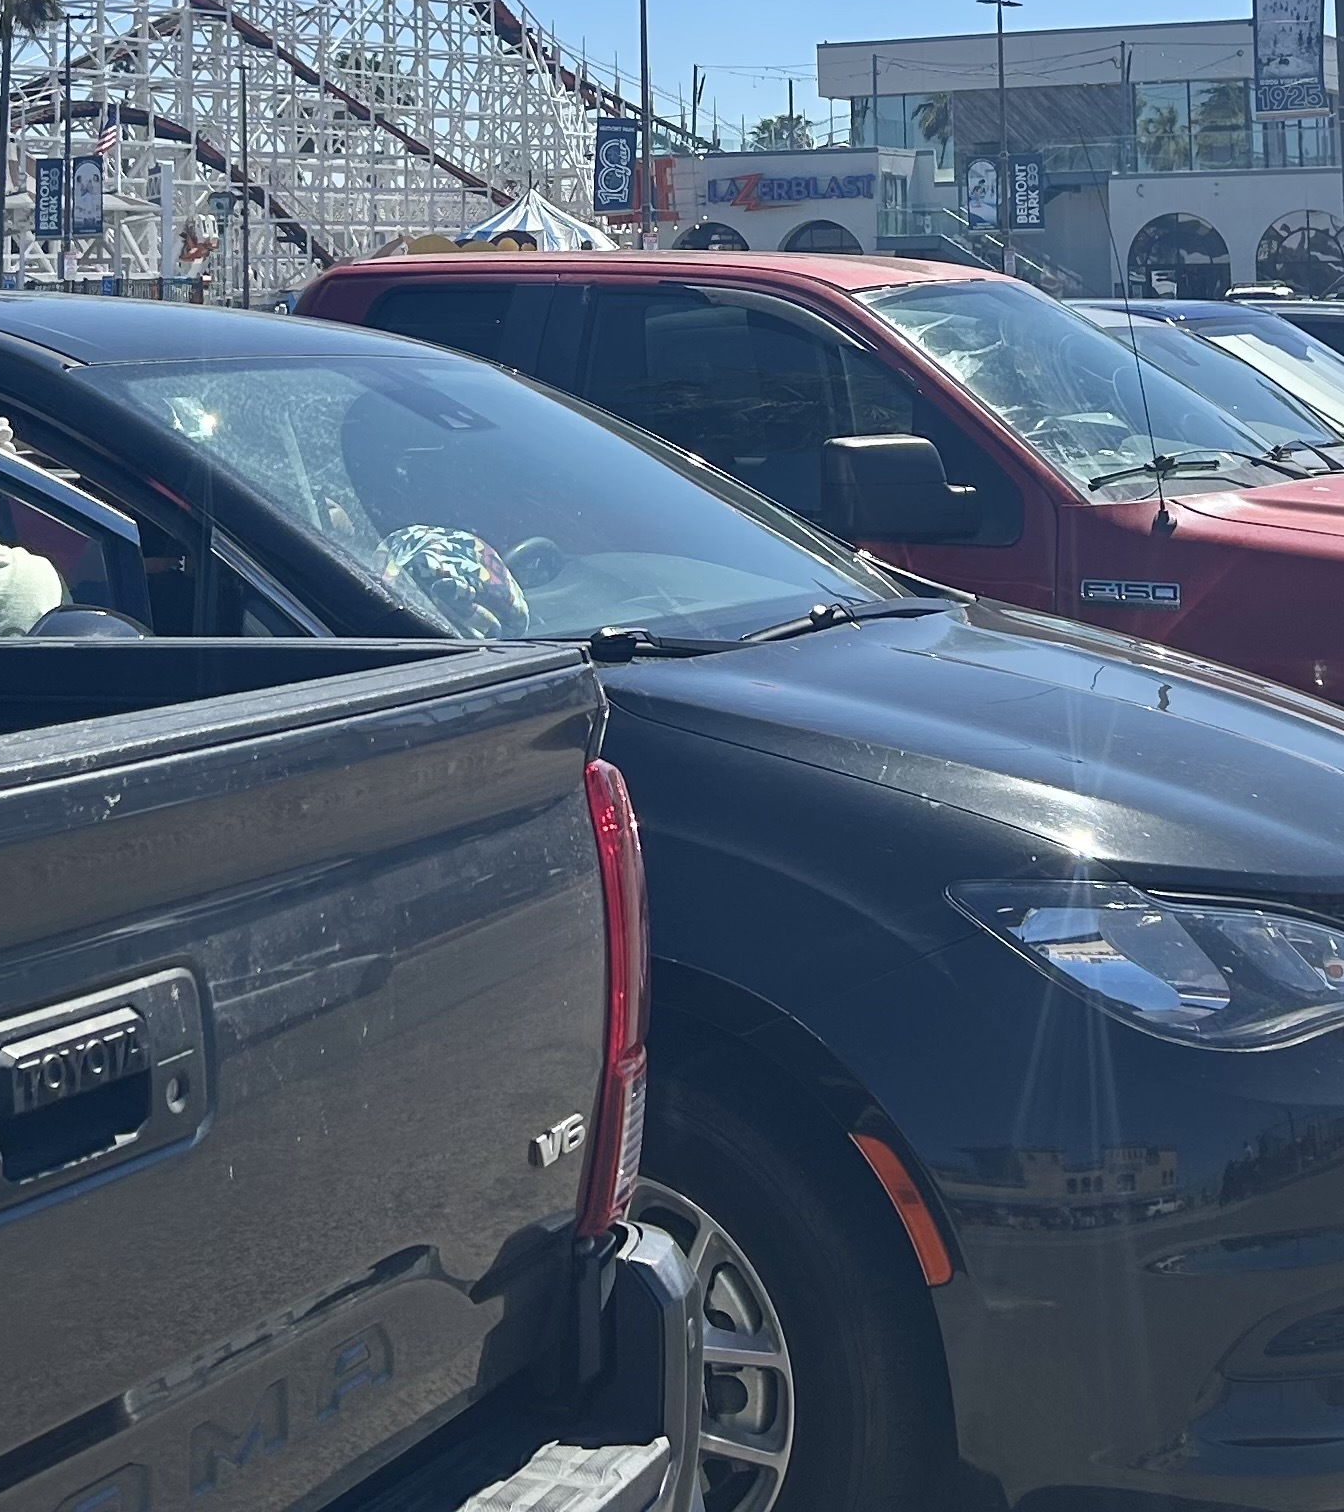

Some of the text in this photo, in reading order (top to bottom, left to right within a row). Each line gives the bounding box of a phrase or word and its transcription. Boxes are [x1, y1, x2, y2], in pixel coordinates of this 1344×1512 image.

[1258, 84, 1324, 110] 1925
[597, 138, 631, 205] 100
[707, 173, 876, 212] LAZERBLAST
[1028, 189, 1040, 223] PARK
[48, 195, 58, 230] PARK
[13, 1026, 146, 1112] TOYOTA
[532, 1113, 586, 1168] V6
